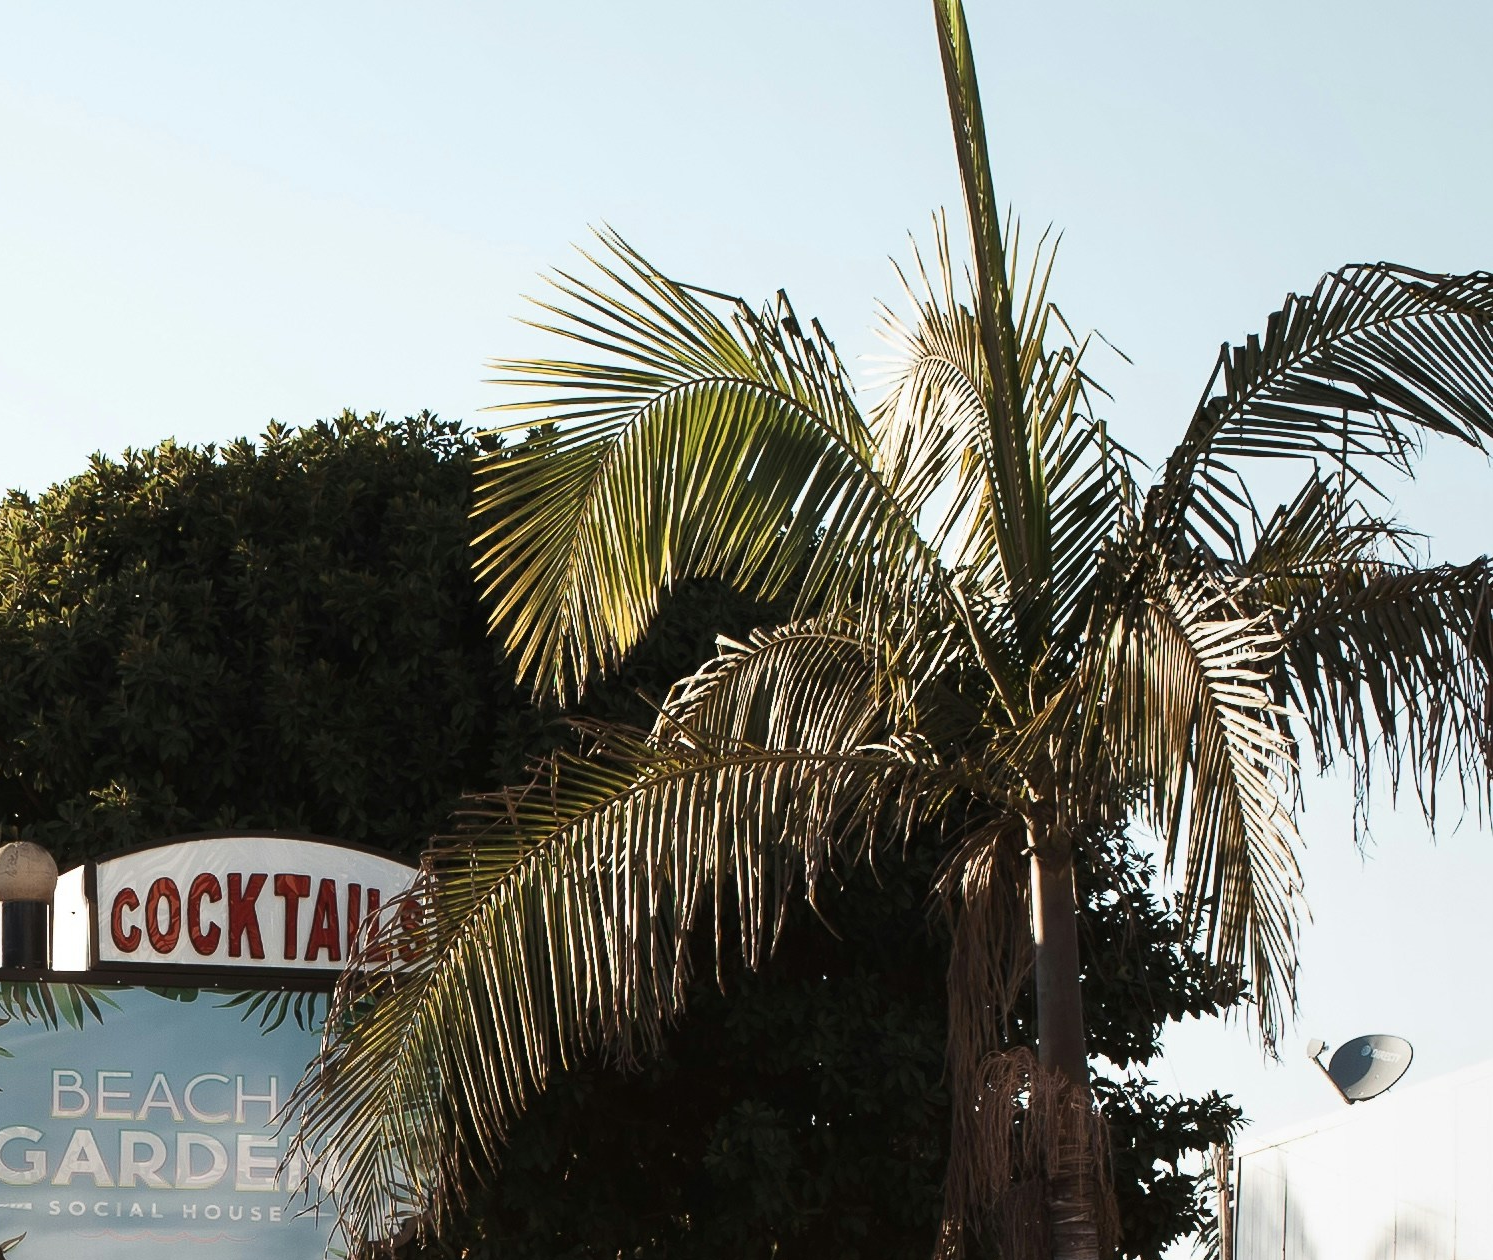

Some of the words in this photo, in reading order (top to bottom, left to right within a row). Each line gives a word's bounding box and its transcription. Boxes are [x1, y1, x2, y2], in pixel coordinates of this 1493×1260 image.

[50, 1069, 279, 1127] BEACH
[48, 1200, 164, 1220] SOCIAL
[183, 1202, 282, 1223] HOUSE
